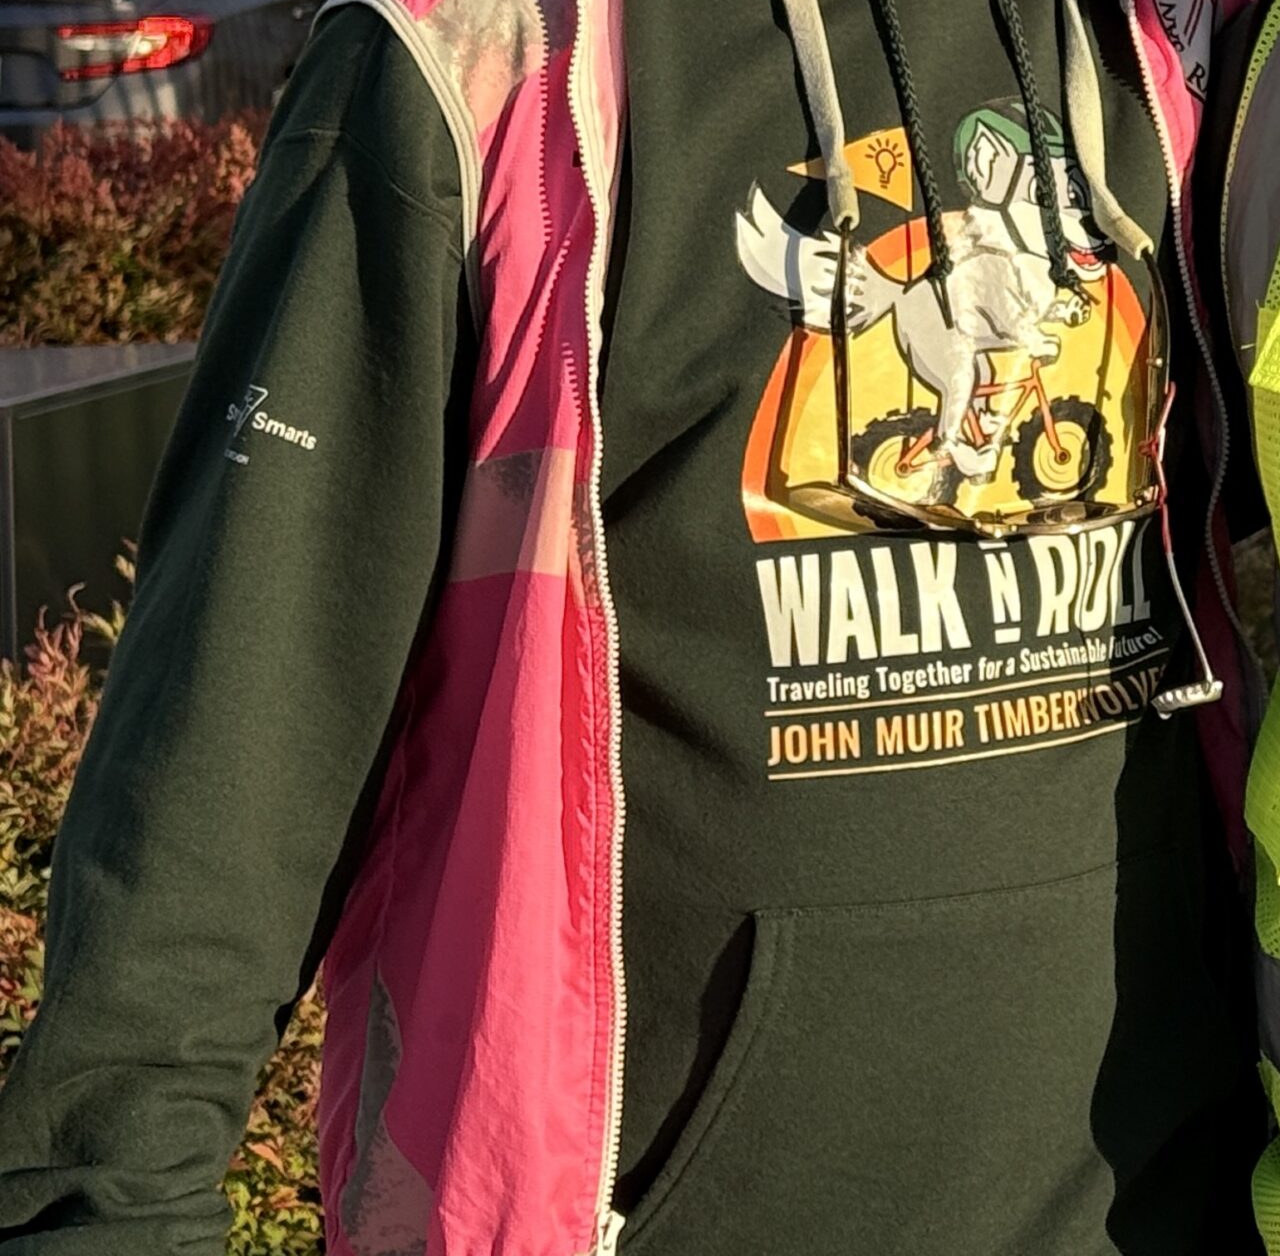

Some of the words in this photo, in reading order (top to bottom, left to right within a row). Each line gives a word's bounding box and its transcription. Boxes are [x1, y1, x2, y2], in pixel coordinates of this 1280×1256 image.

[251, 411, 317, 450] Smarts
[756, 541, 971, 668] WALK
[1027, 519, 1151, 637] ROLL
[766, 674, 870, 703] Traveling
[879, 662, 973, 694] Together
[978, 655, 1004, 680] for
[1005, 657, 1016, 676] a
[1020, 638, 1107, 674] Sustainable
[767, 720, 861, 767] JOHN
[876, 709, 965, 756] MUIR
